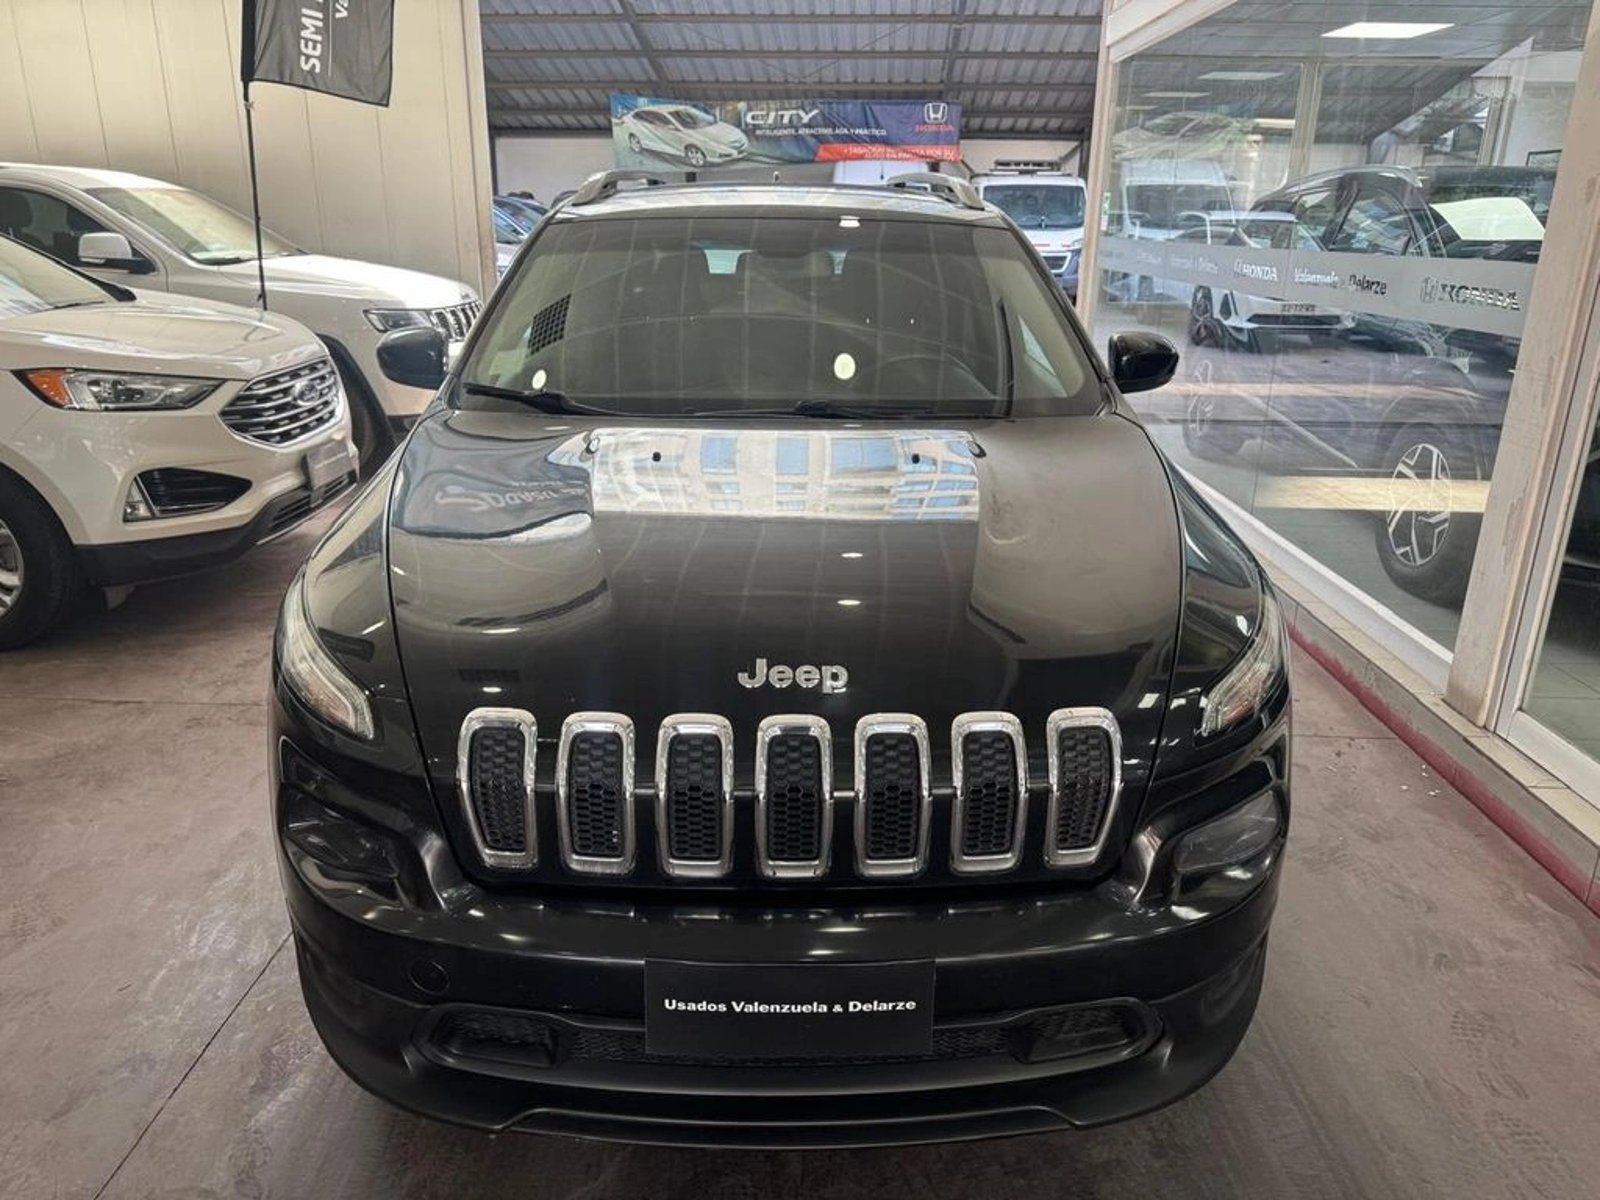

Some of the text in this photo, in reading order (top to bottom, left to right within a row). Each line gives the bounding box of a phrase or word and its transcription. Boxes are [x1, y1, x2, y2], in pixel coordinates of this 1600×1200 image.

[300, 8, 324, 73] SEMI
[746, 109, 819, 124] CITY
[1242, 262, 1278, 281] HONDA
[737, 657, 848, 694] Jeep
[664, 998, 917, 1013] Usados Valenzuela & Delarze
